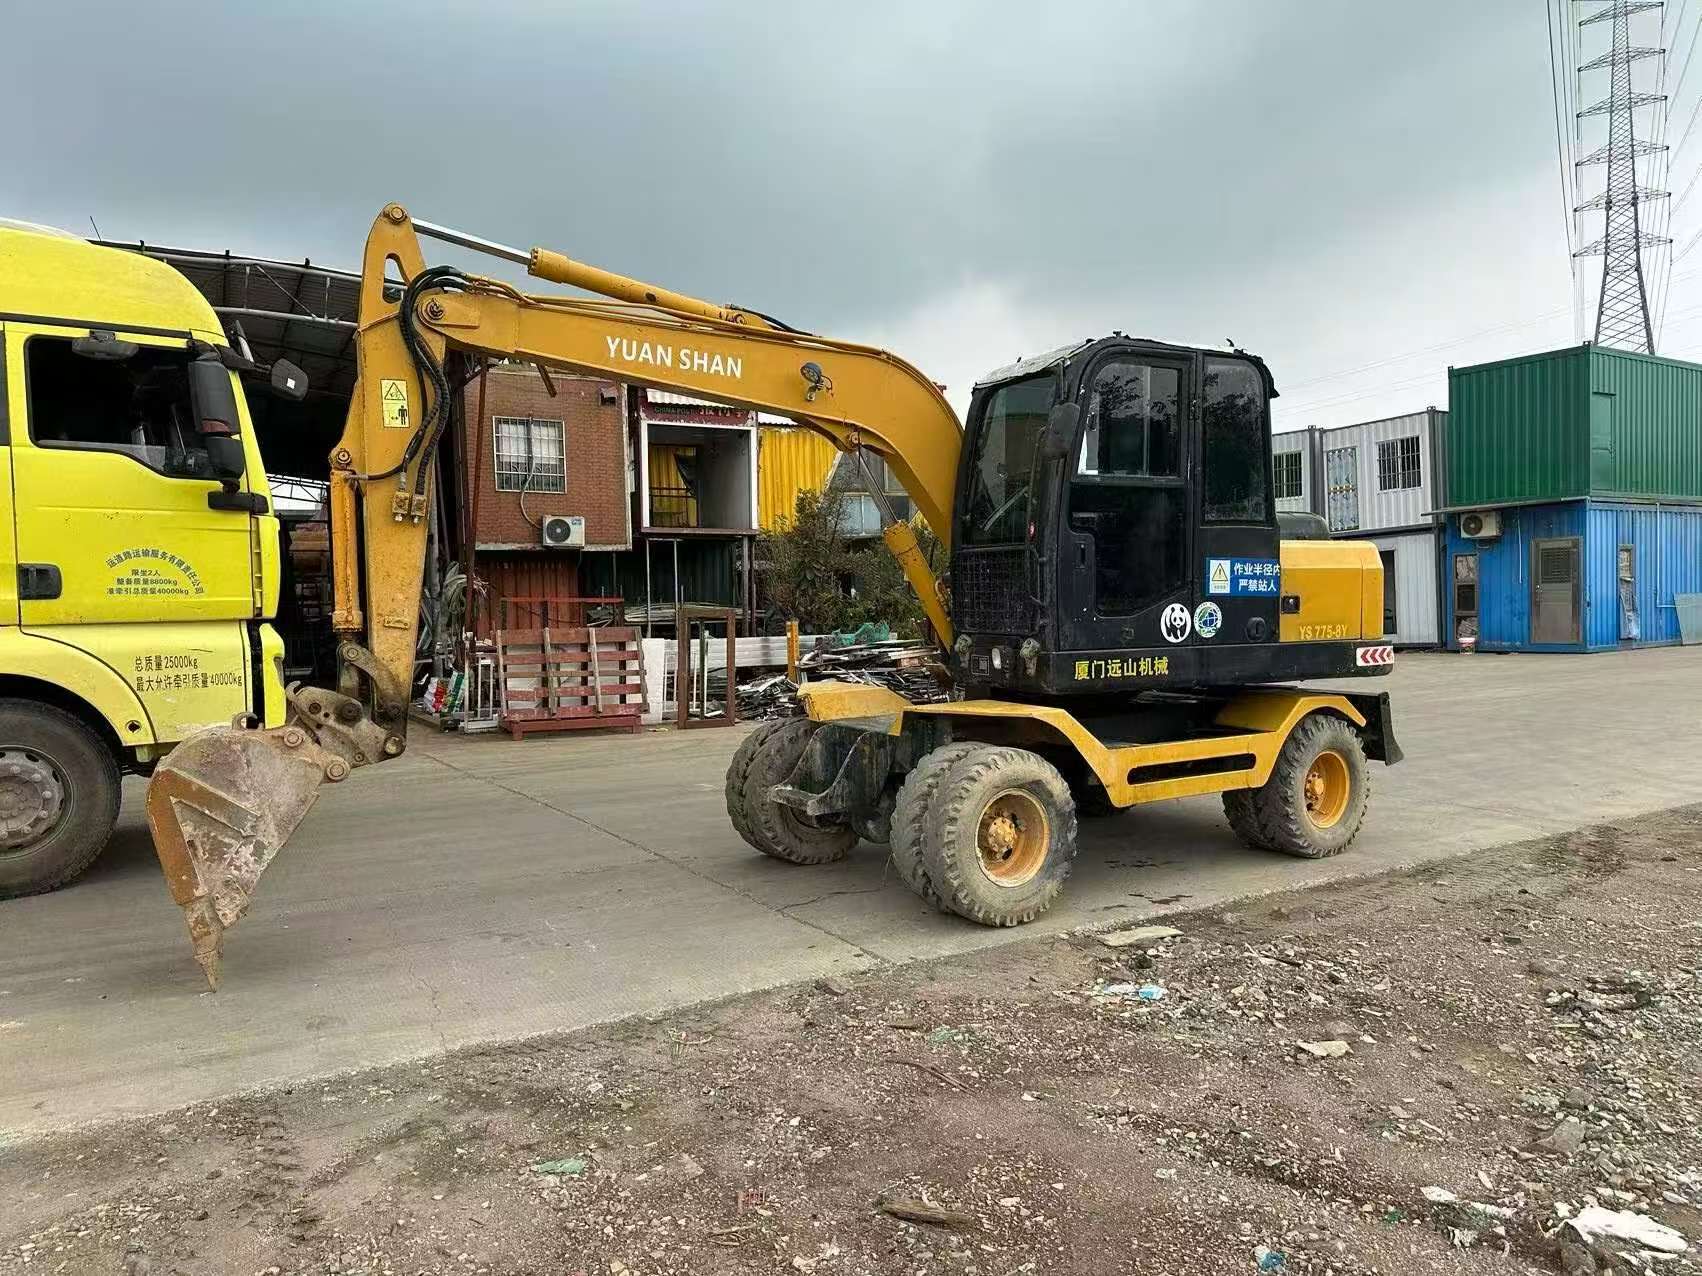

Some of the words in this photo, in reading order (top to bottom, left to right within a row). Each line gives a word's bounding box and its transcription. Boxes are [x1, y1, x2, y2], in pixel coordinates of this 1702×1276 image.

[606, 335, 672, 367] YUAN
[679, 348, 742, 379] SHAN
[1233, 562, 1280, 577] 作业半径内
[1238, 578, 1277, 592] 严禁站人
[1299, 625, 1313, 640] YS
[1074, 656, 1169, 681] 厦门远山机械
